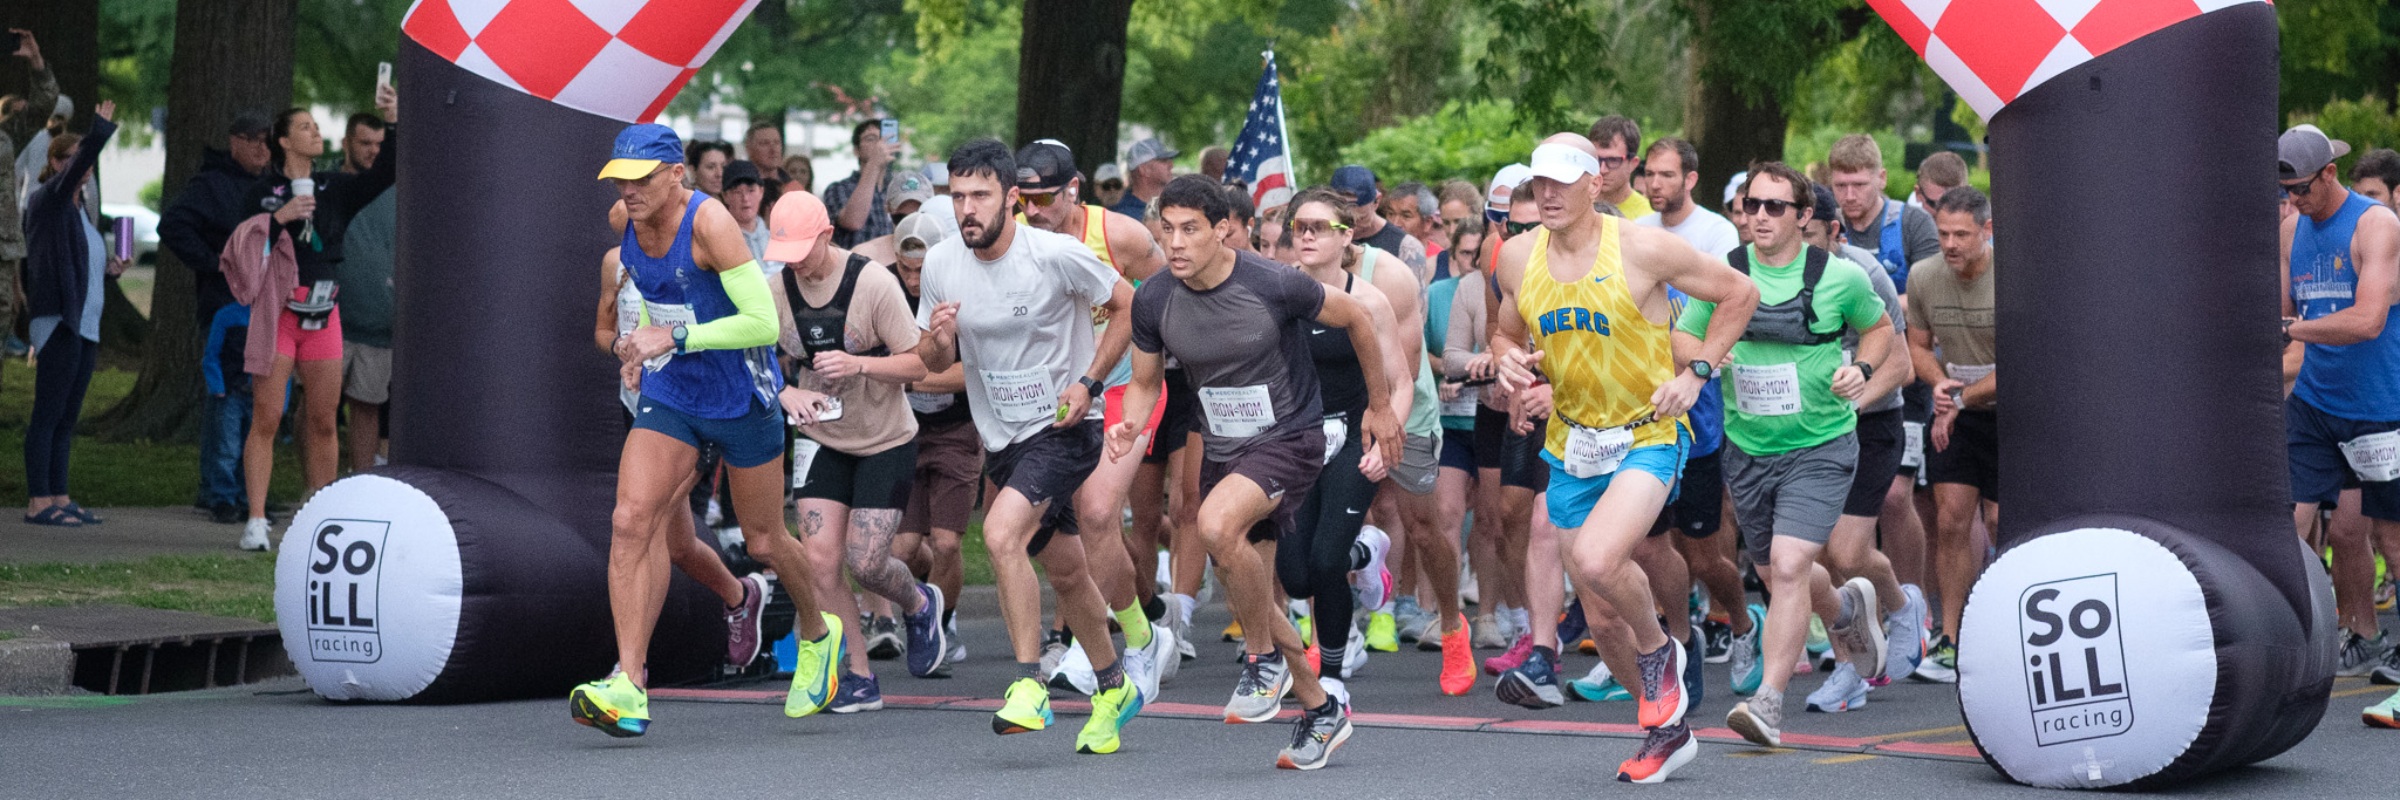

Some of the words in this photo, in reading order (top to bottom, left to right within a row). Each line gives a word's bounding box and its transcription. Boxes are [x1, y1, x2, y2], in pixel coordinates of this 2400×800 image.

[1013, 306, 1028, 316] 20
[1538, 307, 1610, 337] NERC
[1018, 382, 1045, 400] MOM
[1766, 379, 1790, 395] MOM
[1037, 403, 1052, 413] 714
[1239, 402, 1264, 417] MOM
[1781, 403, 1794, 411] 107
[1600, 441, 1625, 458] MOM
[311, 524, 376, 575] So
[310, 580, 374, 627] iLL
[2026, 588, 2111, 646] So
[314, 636, 374, 657] racing
[2031, 647, 2122, 705] iLL
[2042, 709, 2123, 733] racing
